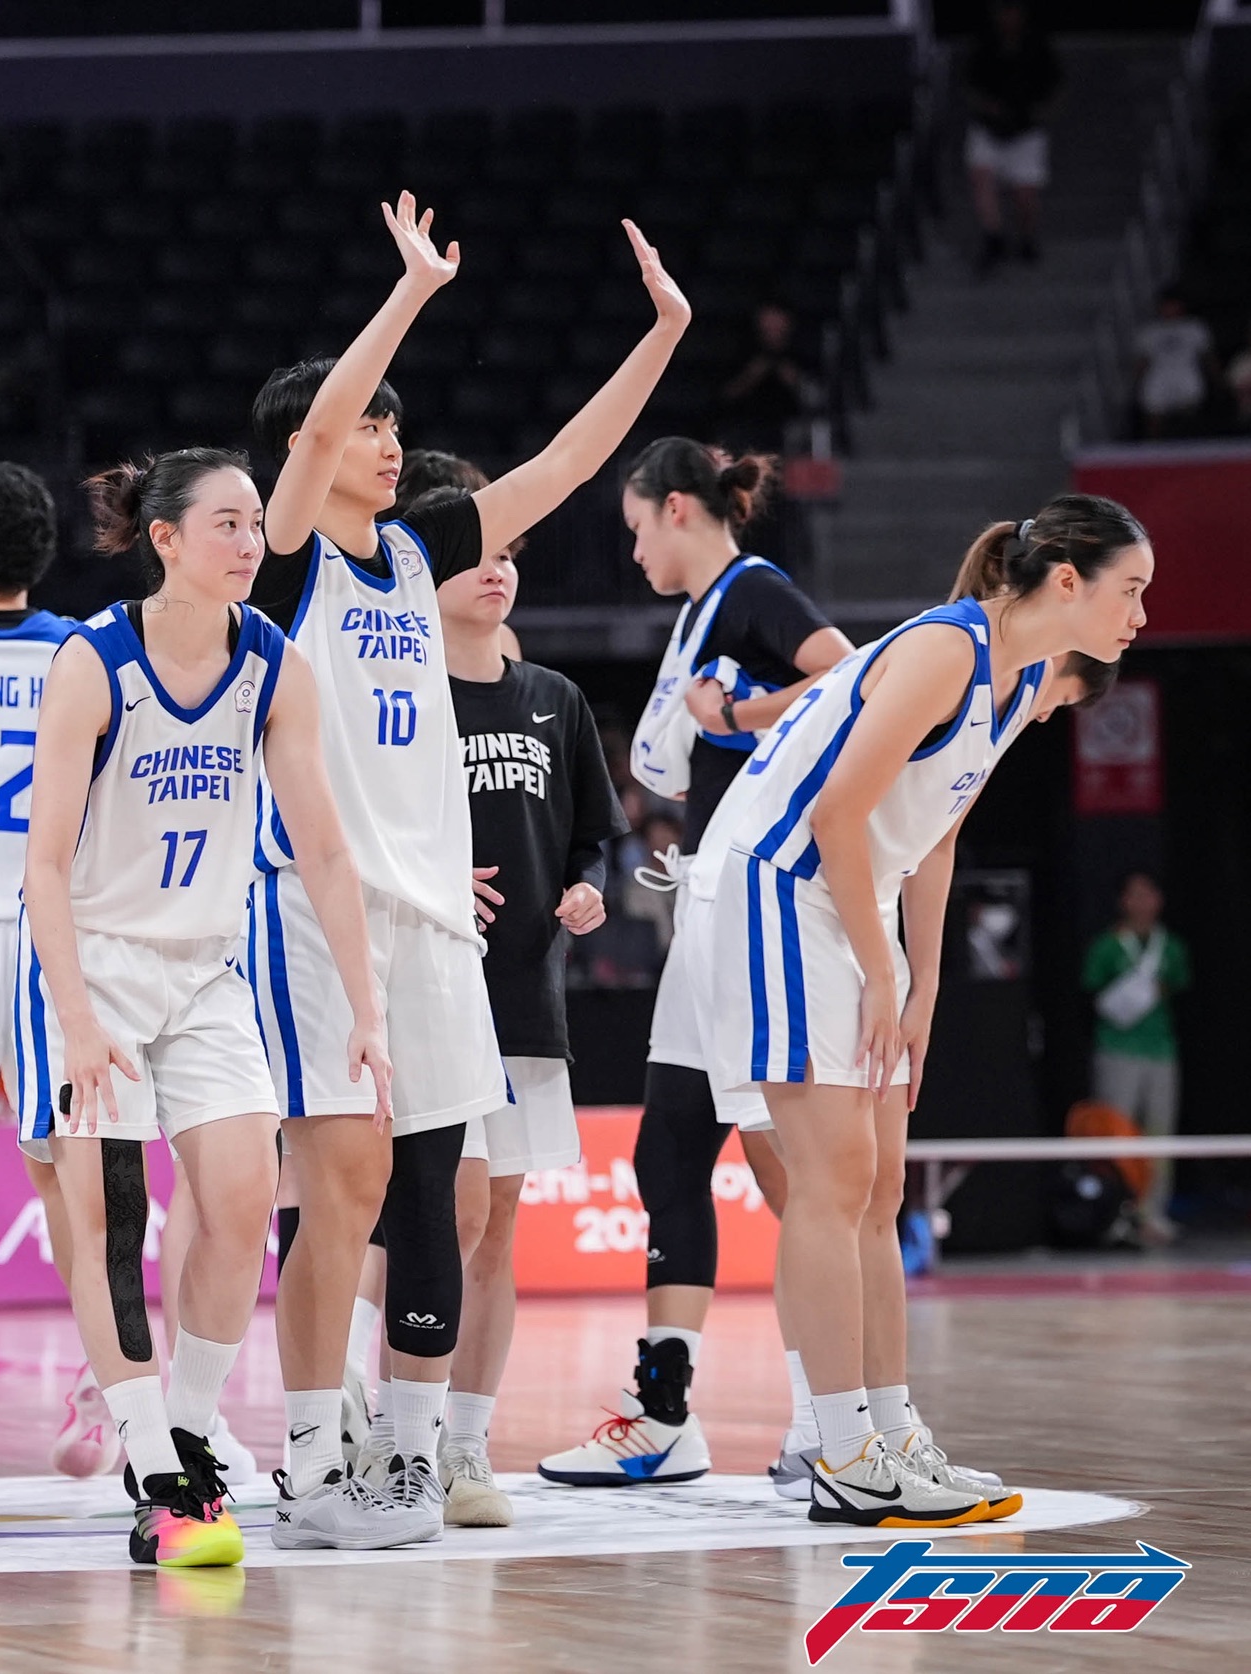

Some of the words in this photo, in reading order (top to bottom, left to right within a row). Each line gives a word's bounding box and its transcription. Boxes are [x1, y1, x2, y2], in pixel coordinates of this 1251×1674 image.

[341, 607, 431, 639] CHINEE
[372, 688, 417, 746] 10
[130, 745, 244, 779] CHINESE
[148, 774, 231, 805] TAIPEI
[160, 829, 207, 888] 17
